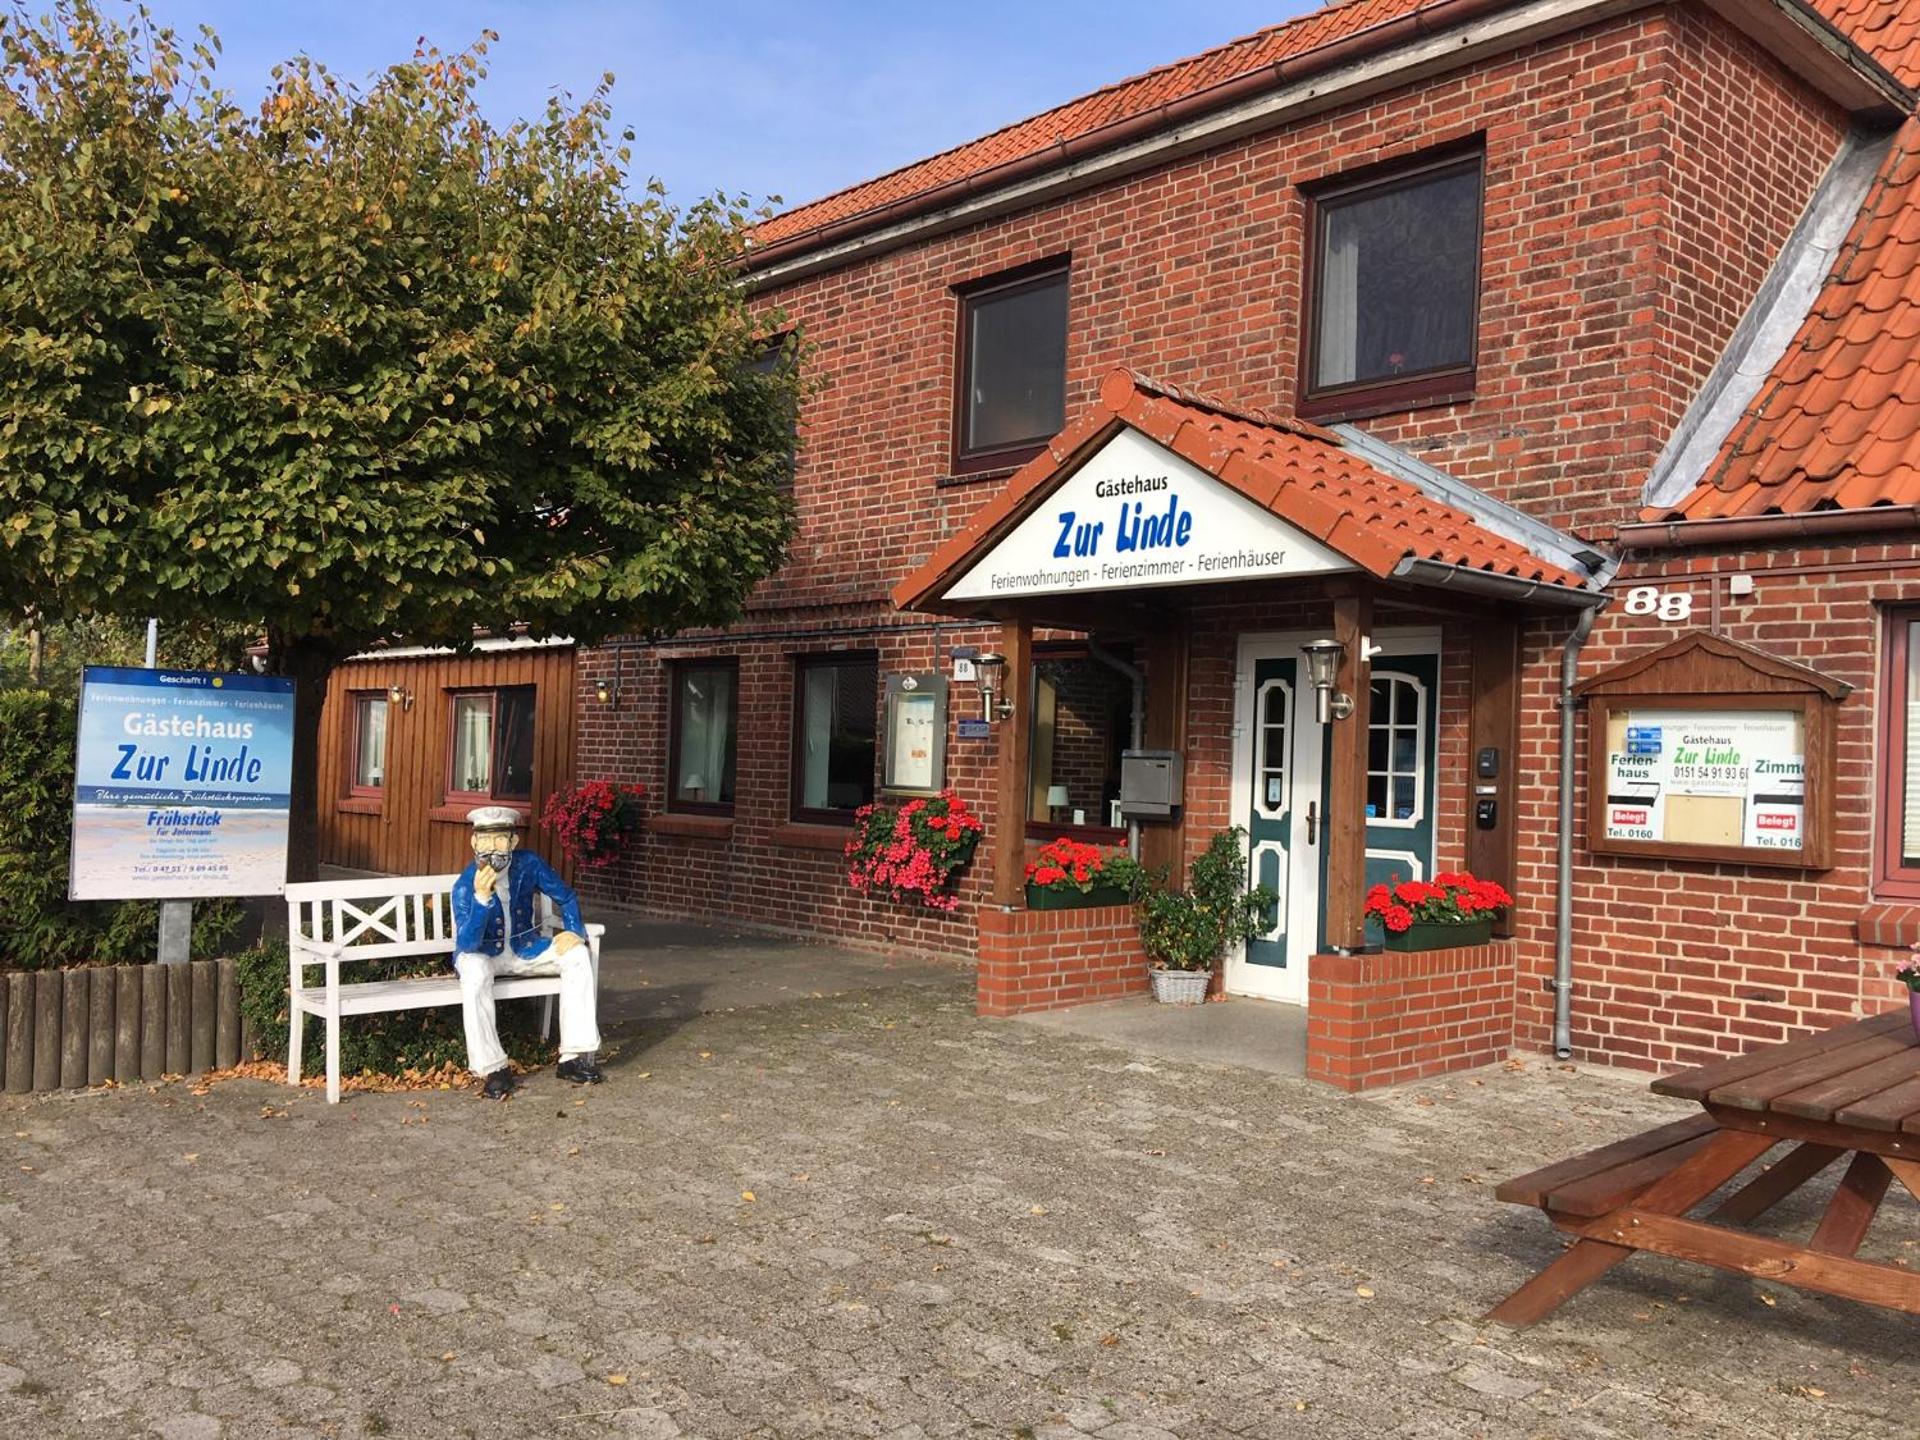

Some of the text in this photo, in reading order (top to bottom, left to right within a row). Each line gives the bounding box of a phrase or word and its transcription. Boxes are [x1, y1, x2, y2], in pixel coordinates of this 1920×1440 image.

[1095, 475, 1169, 499] Gästehaus
[1053, 494, 1192, 558] Zur Linde
[991, 567, 1090, 590] Ferienwohnungen
[1102, 559, 1185, 581] Ferienzimmer
[1197, 549, 1286, 572] Ferienhäuser
[1624, 586, 1693, 622] 88
[959, 662, 969, 674] 88
[159, 675, 201, 685] Geschafft
[123, 712, 254, 739] Gästehaus
[1683, 736, 1732, 745] Gästehaus
[1611, 754, 1658, 767] Ferien-
[1674, 747, 1741, 765] Zur Linde
[111, 744, 262, 783] Zur Linde
[1617, 768, 1649, 779] haus
[1674, 767, 1695, 778] 0151
[1698, 767, 1709, 778] 54
[1711, 767, 1722, 779] 91
[1725, 768, 1737, 779] 93
[147, 810, 222, 826] Frühstück
[1614, 812, 1646, 822] Belegt
[1758, 816, 1794, 828] Belegt
[1608, 828, 1653, 838] Tel. 0160
[1757, 837, 1776, 846] Tel.
